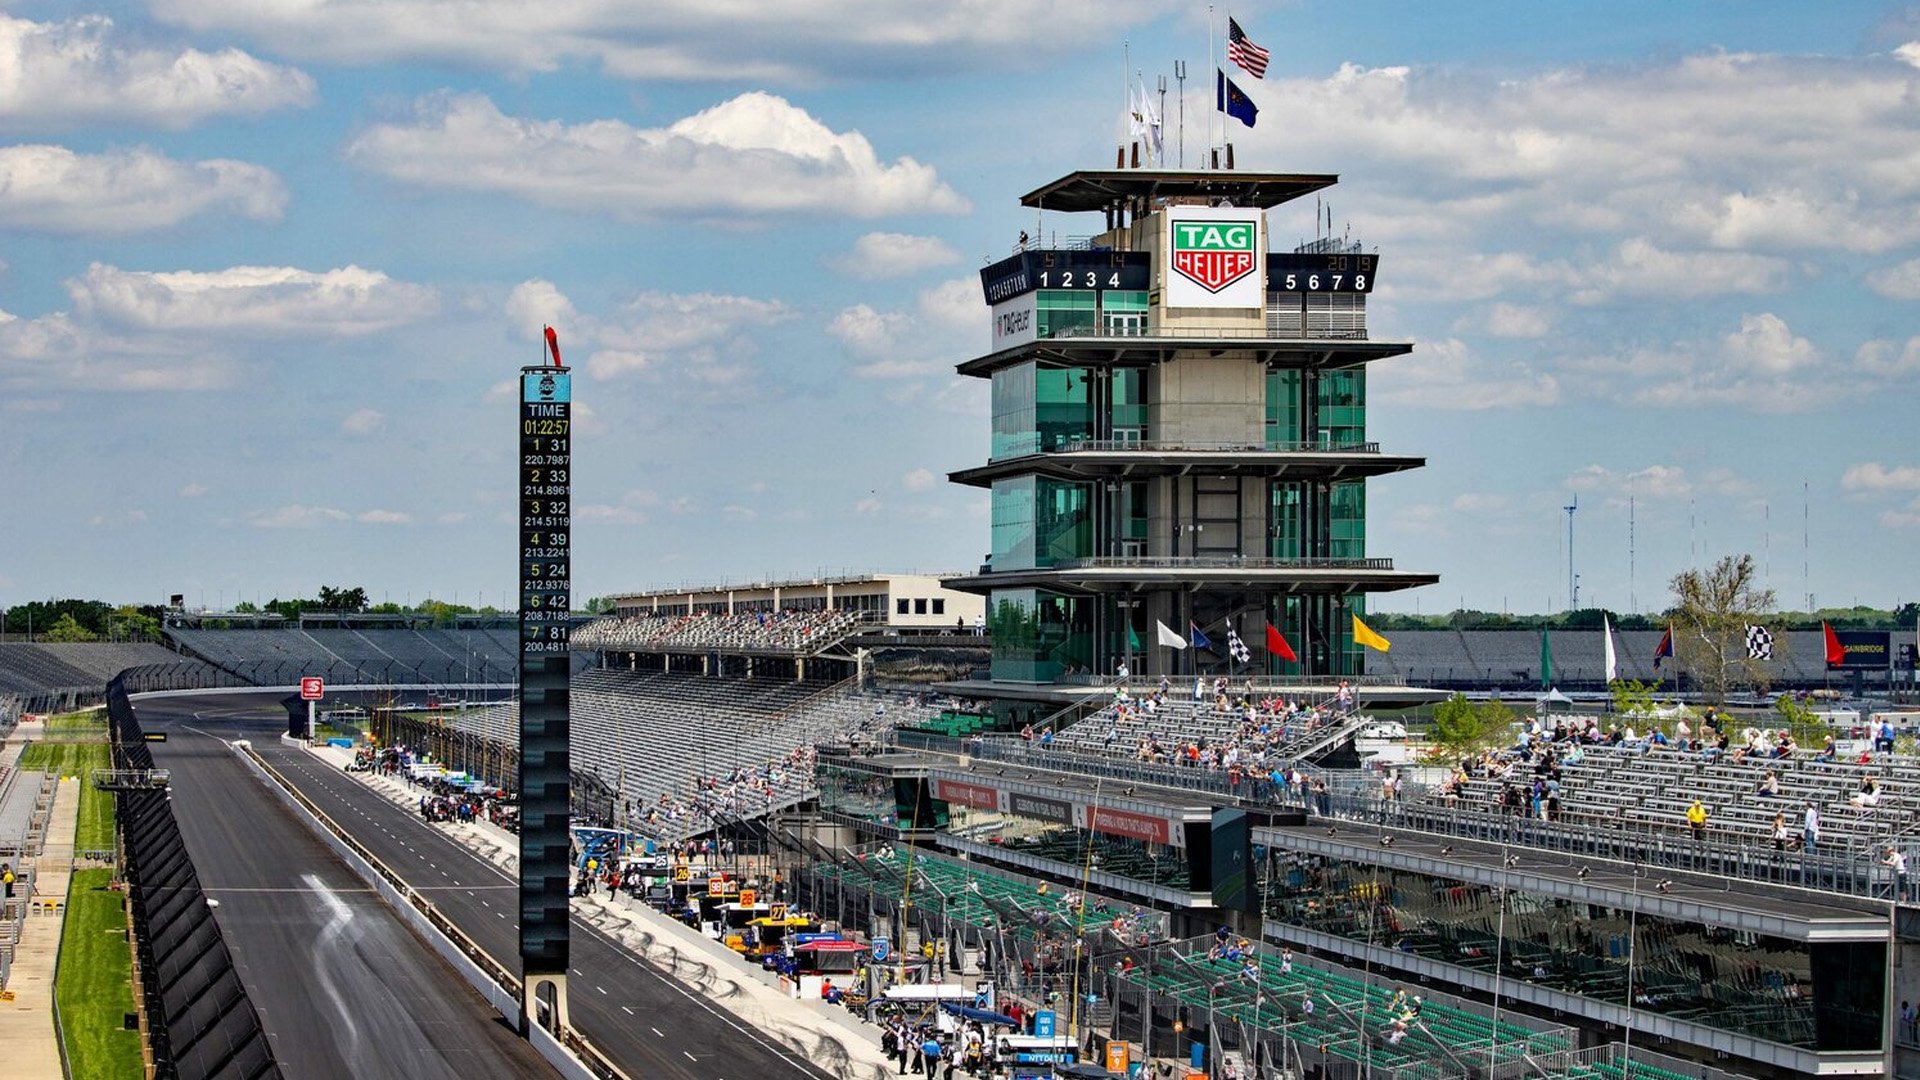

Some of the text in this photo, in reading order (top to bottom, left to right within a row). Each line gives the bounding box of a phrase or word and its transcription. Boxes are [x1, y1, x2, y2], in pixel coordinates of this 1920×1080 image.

[1180, 226, 1247, 248] TAG
[1178, 253, 1250, 287] HEUER
[1040, 271, 1120, 288] 1 2 3 4
[1286, 275, 1366, 290] 5 6 7 8
[528, 404, 565, 417] TIME
[524, 420, 569, 435] 01:22:57
[533, 439, 567, 451] 1 31
[524, 455, 570, 465] 220.7987
[531, 470, 567, 482] 2 33
[524, 485, 570, 495] 214.8961
[531, 501, 567, 514] 3 32
[524, 516, 570, 526] 214.5119
[531, 533, 567, 546] 4 39
[524, 547, 570, 557] 213.2241
[531, 564, 566, 577] 5 24
[524, 580, 570, 590] 212.9376
[531, 595, 567, 608] 6 42
[524, 611, 570, 621] 208.7188
[530, 626, 566, 639] 7 81
[524, 642, 570, 652] 200.4811
[656, 855, 667, 866] 25
[677, 868, 687, 880] 26
[772, 907, 784, 919] 27
[1113, 1057, 1121, 1067] 9
